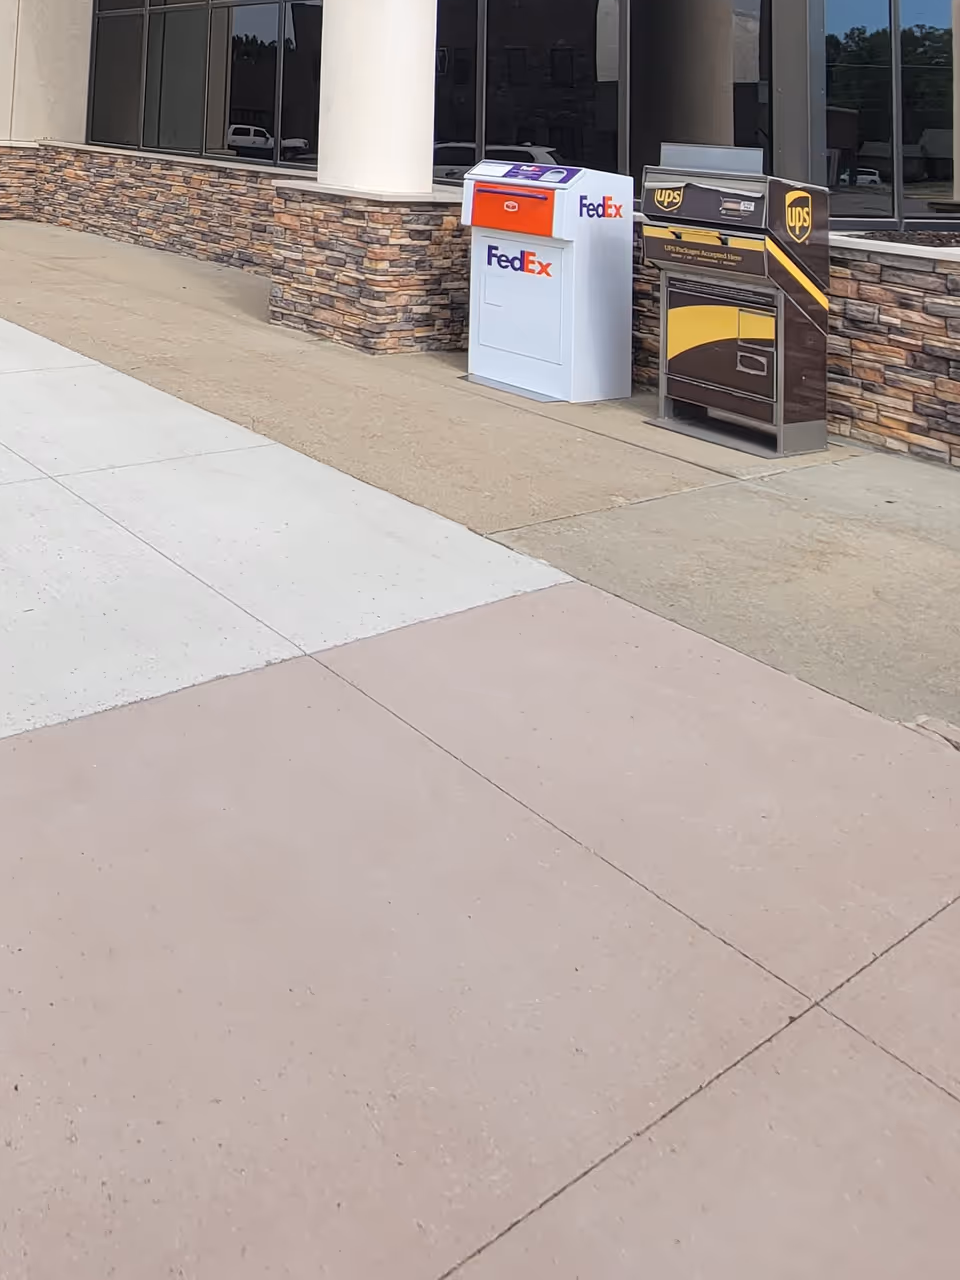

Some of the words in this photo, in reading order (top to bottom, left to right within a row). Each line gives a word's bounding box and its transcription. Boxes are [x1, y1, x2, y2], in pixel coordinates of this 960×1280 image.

[579, 195, 623, 218] FedEx
[657, 189, 681, 206] ups
[787, 206, 810, 234] ups
[487, 244, 552, 277] FedEx
